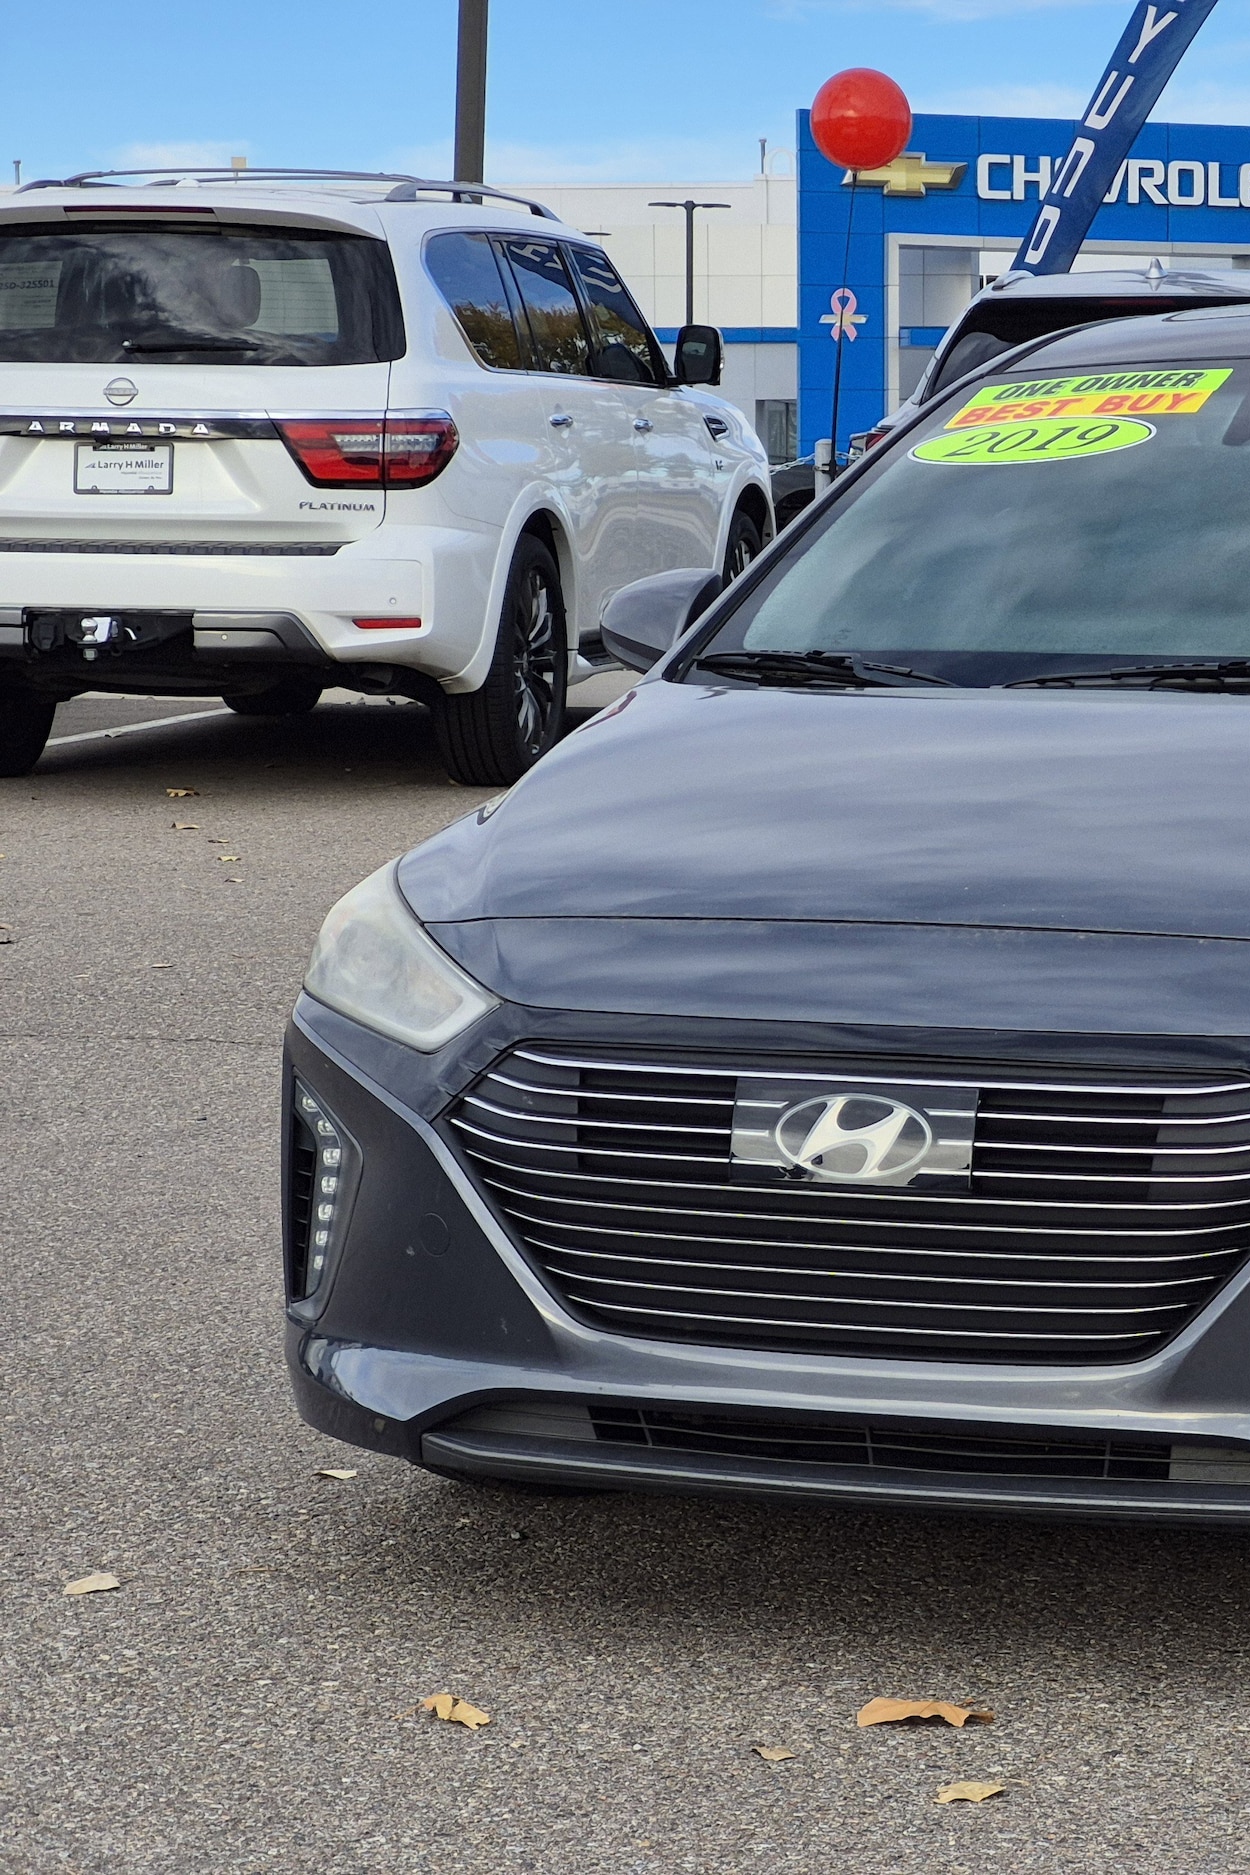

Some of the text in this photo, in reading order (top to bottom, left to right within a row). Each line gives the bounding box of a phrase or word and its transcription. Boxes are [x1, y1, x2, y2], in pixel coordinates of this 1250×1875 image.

[1023, 0, 1187, 265] YUND
[992, 371, 1206, 401] ONE OWNER
[955, 391, 1200, 426] BEST BUY
[27, 420, 209, 435] ARMADA
[941, 423, 1120, 458] 2019
[97, 460, 164, 471] Larry H Miller
[298, 501, 375, 512] PLATINUM
